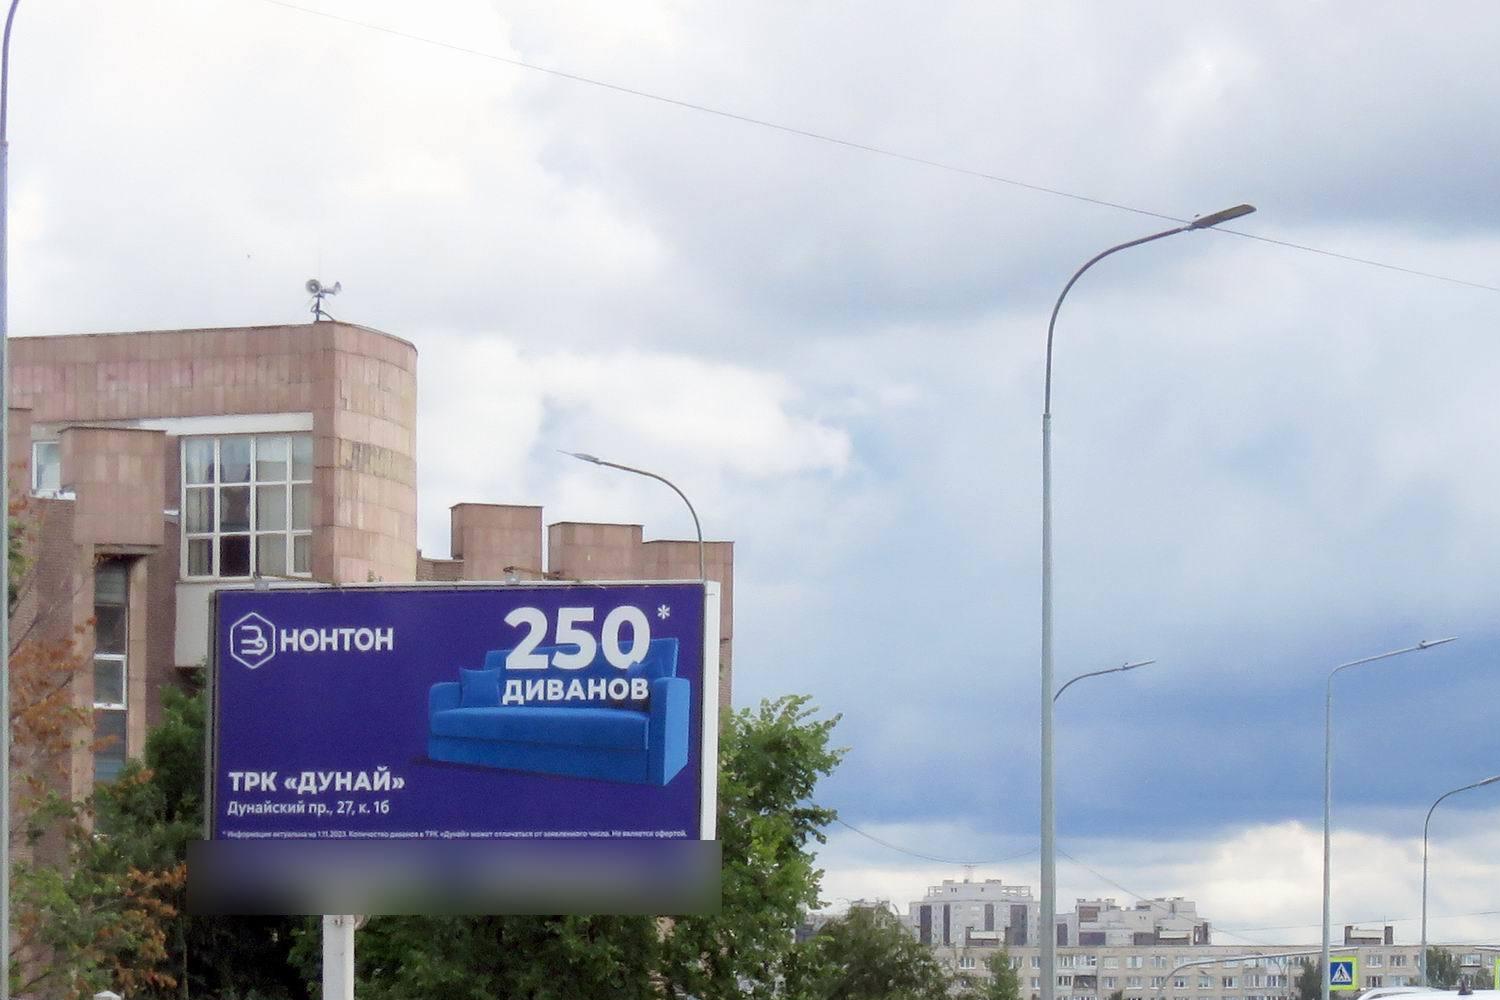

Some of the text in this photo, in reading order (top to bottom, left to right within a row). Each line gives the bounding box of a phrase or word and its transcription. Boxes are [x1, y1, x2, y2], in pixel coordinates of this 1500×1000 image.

[280, 627, 394, 652] НОНТОН
[502, 678, 649, 705] ДИВАНОВ
[228, 766, 405, 795] ТРК «ДУНАЙ»
[227, 800, 305, 817] Дунайский
[308, 803, 334, 817] пр.,
[337, 801, 356, 816] 27,
[359, 803, 371, 814] к.
[349, 831, 389, 839] Количество
[425, 831, 438, 839] ТРК
[471, 831, 492, 839] может
[494, 831, 533, 839] отличаться
